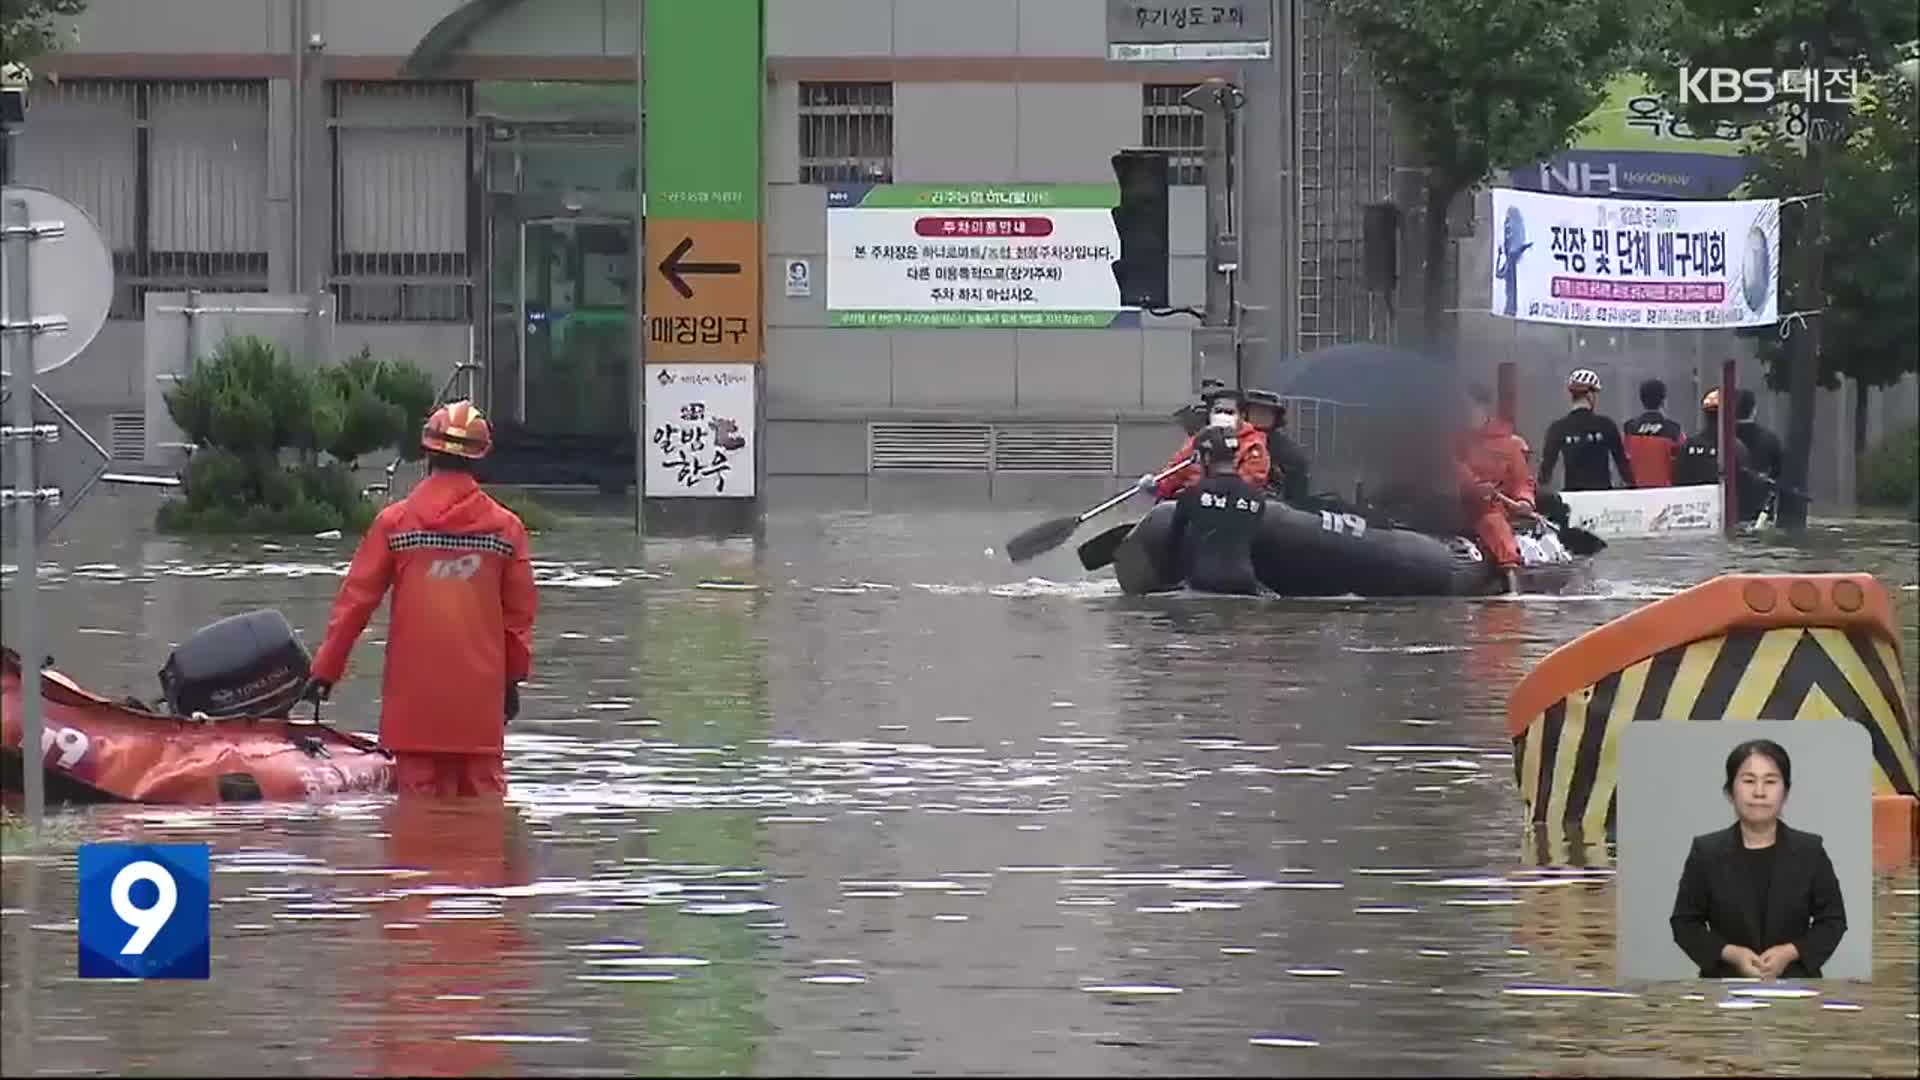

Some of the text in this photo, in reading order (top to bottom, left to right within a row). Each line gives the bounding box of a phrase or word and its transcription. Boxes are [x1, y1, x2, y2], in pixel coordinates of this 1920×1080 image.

[1540, 160, 1617, 193] NH
[854, 245, 867, 259] 본
[1550, 226, 1726, 277] 직장 및 단체 배구대회
[906, 266, 931, 281] 다른
[930, 287, 955, 302] 주차
[958, 287, 983, 301] 하지
[651, 315, 749, 345] 매장입구
[653, 424, 708, 454] 알밤
[662, 450, 731, 492] 한우
[1320, 509, 1368, 538] 119
[425, 554, 482, 583] 119
